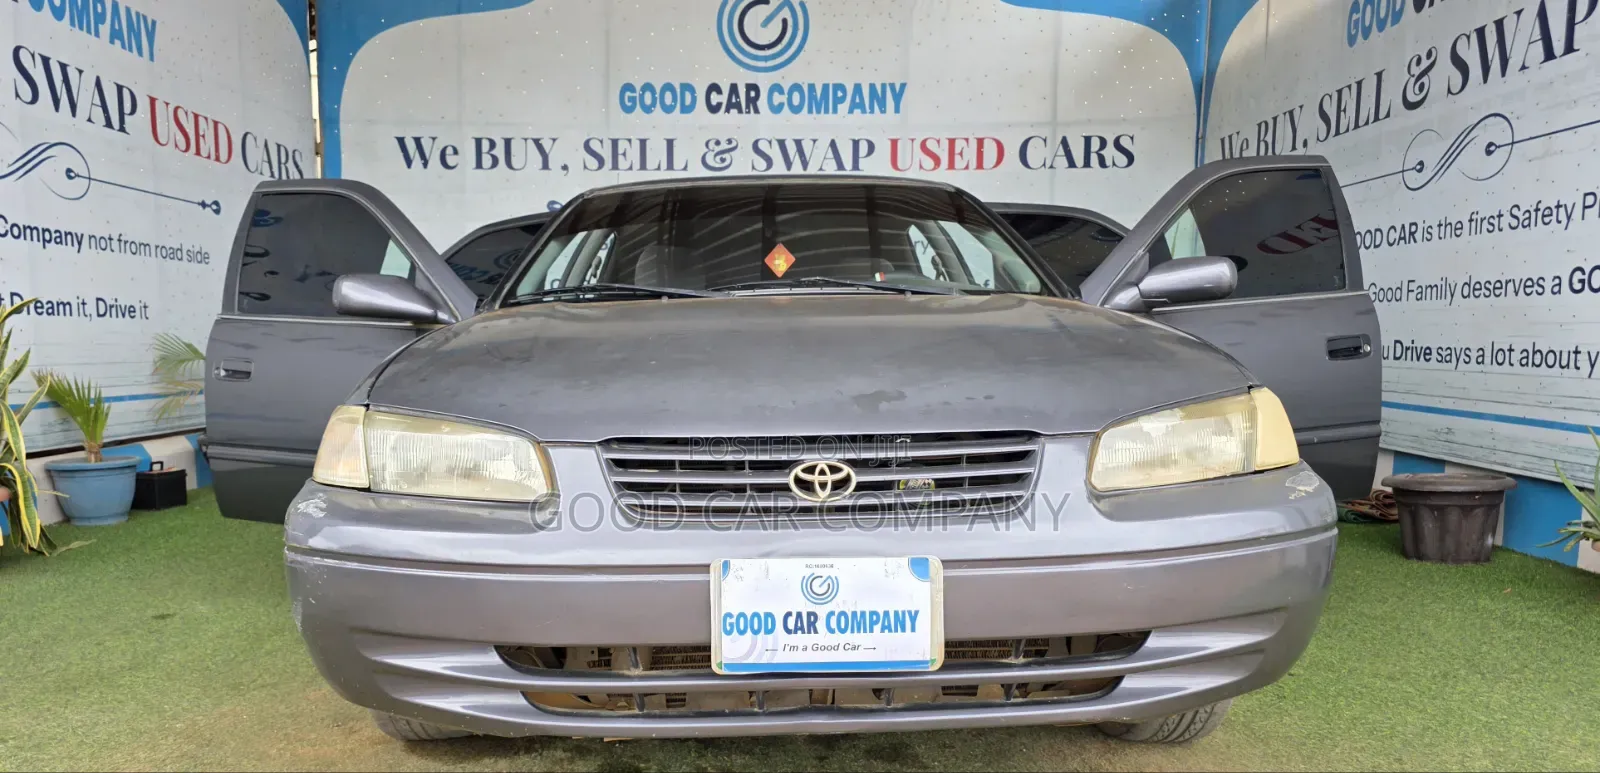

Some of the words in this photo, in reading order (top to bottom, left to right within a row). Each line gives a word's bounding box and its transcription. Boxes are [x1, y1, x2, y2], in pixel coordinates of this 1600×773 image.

[28, 0, 157, 62] MPANY
[1316, 69, 1391, 143] SELL
[1401, 46, 1438, 111] &
[1447, 0, 1600, 98] SWAP
[12, 45, 138, 135] SWAP
[147, 95, 233, 164] USED
[241, 131, 304, 180] CARS
[619, 82, 697, 114] GOOD
[705, 82, 761, 114] CAR
[767, 82, 907, 114] COMPANY
[394, 136, 459, 170] We
[472, 136, 570, 176] BUY,
[583, 137, 688, 172] SELL
[701, 138, 739, 172] &
[751, 138, 876, 172] SWAP
[888, 136, 1005, 172] USED
[1018, 134, 1135, 171] CARS
[0, 214, 84, 253] Company
[88, 233, 115, 253] not
[117, 233, 152, 257] from
[154, 244, 183, 262] road
[186, 244, 211, 265] side
[1355, 227, 1383, 250] OOD
[1386, 221, 1418, 247] CAR
[1421, 220, 1433, 242] is
[1437, 216, 1463, 240] the
[1468, 210, 1504, 236] first
[1508, 199, 1576, 231] Safety
[1368, 280, 1403, 303] Good
[1406, 277, 1457, 306] Family
[1461, 275, 1546, 299] deserves
[1551, 275, 1562, 295] a
[1568, 265, 1600, 294] GO
[76, 295, 92, 321] it,
[95, 297, 136, 320] Drive
[139, 299, 149, 320] it
[1393, 339, 1432, 363] Drive
[1436, 344, 1471, 370] says
[1475, 346, 1485, 366] a
[1490, 341, 1515, 367] lot
[1519, 341, 1581, 370] about
[722, 611, 776, 636] GOOD
[783, 611, 819, 635] CAR
[825, 609, 920, 634] COMPANY
[783, 643, 798, 652] I'm
[802, 644, 808, 652] a
[811, 643, 840, 652] Good
[843, 642, 861, 651] Car
